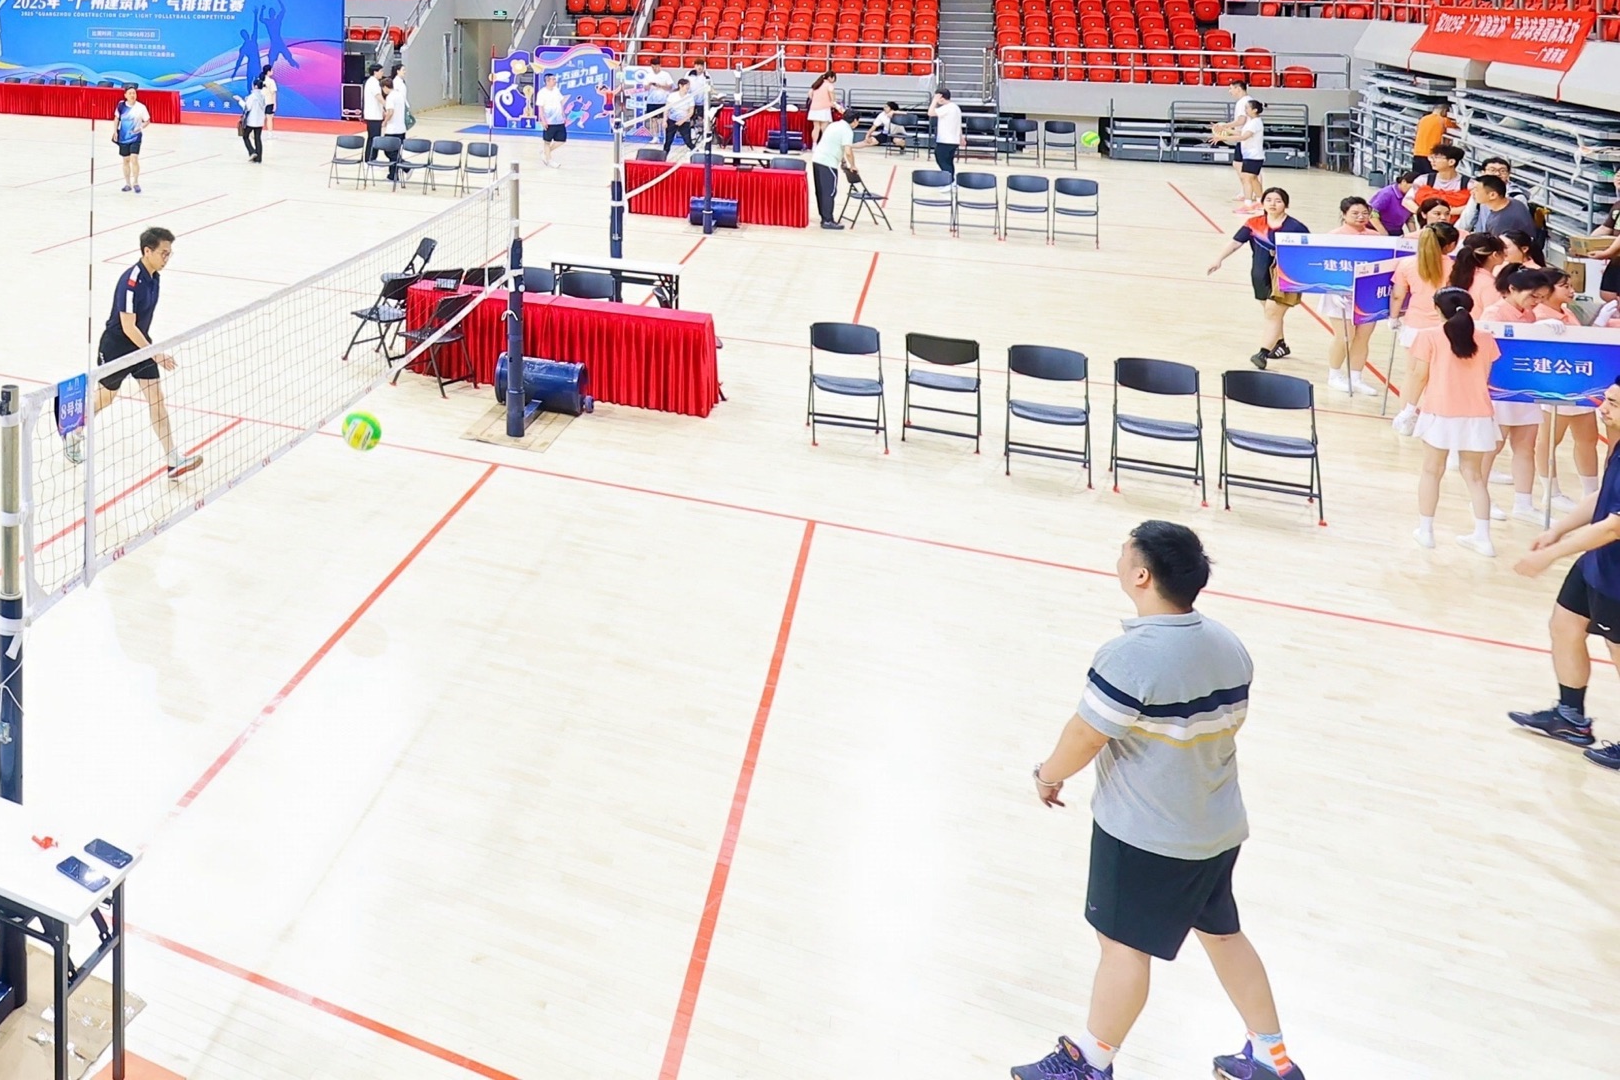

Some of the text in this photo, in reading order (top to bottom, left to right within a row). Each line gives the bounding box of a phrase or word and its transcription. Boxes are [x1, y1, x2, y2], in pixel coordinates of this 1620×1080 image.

[1511, 357, 1594, 377] 三建公司
[60, 398, 84, 420] 8号场
